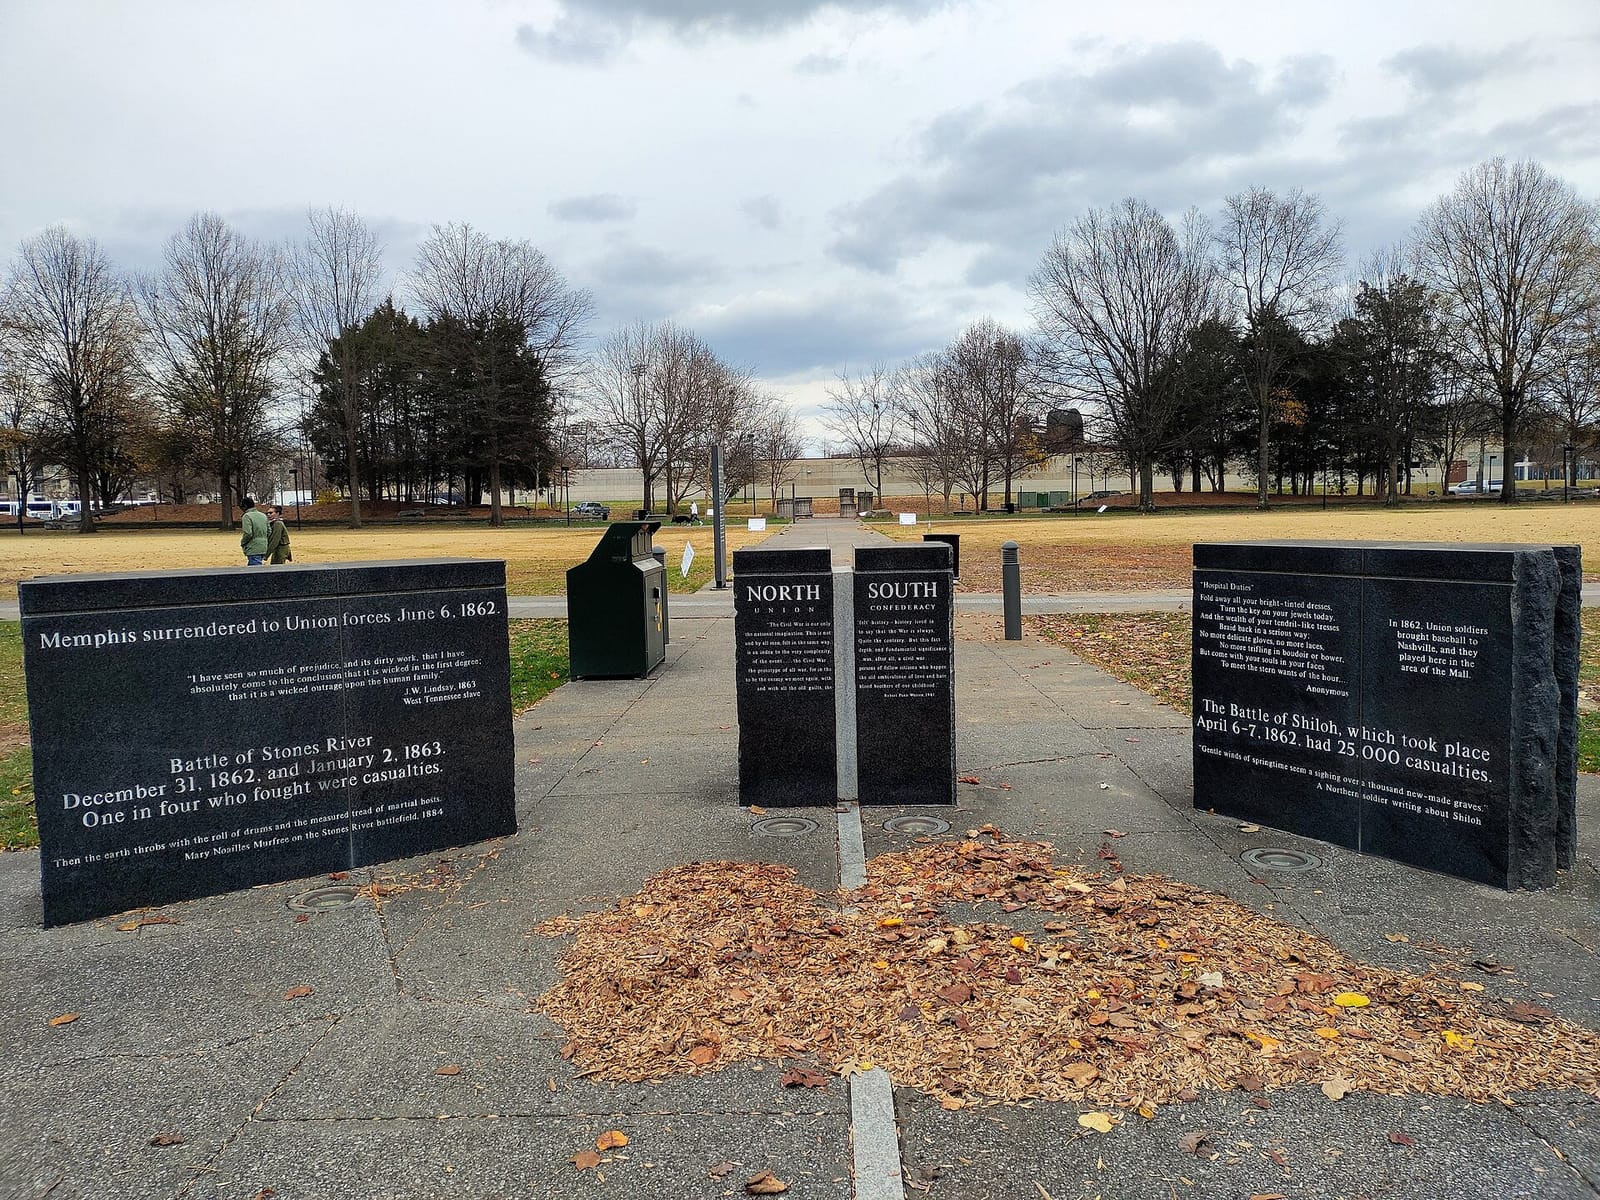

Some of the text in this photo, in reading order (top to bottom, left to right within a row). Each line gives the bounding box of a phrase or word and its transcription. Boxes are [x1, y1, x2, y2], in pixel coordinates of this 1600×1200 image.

[746, 585, 820, 601] NORTH
[867, 582, 937, 598] SOUTH
[39, 629, 137, 648] Memphis
[142, 620, 256, 641] surrendered
[261, 620, 280, 632] to
[285, 615, 337, 630] Union
[342, 613, 391, 625] forces
[397, 608, 435, 621] June
[461, 601, 500, 616] 1862.
[1389, 619, 1398, 627] In
[1426, 622, 1452, 631] Union
[1454, 625, 1488, 634] soldiers
[1397, 631, 1429, 641] brought
[1432, 634, 1466, 643] baseball
[1399, 653, 1475, 667] played here in the
[1459, 648, 1478, 658] they
[259, 667, 284, 675] much
[287, 665, 297, 673] of
[344, 659, 358, 667] and
[1432, 667, 1446, 675] the
[1449, 668, 1471, 678] Mall.
[458, 680, 476, 689] 1863
[424, 694, 461, 702] Tennessee
[1202, 699, 1225, 714] The
[1229, 704, 1269, 722] Battle
[1273, 712, 1289, 725] of
[1347, 727, 1395, 744] which
[1401, 735, 1437, 751] took
[1444, 742, 1490, 761] place
[169, 736, 373, 773] Battle of Stones River
[1196, 716, 1227, 731] April
[1305, 735, 1331, 751] had
[1337, 740, 1400, 764] 25,000
[1405, 757, 1492, 782] casualties.
[63, 785, 166, 808] December
[267, 763, 299, 779] and
[306, 755, 374, 772] January
[404, 742, 446, 758] 1863.
[1224, 751, 1242, 759] winds
[1252, 758, 1288, 769] springtime
[1314, 770, 1341, 782] sighing
[1342, 777, 1359, 785] over
[1368, 781, 1404, 794] thousand
[1406, 791, 1451, 804] new-made
[81, 762, 443, 827] One in four who fought were casualties.
[1326, 784, 1359, 797] Northern
[1362, 794, 1388, 804] soldier
[1392, 800, 1422, 813] writing
[1425, 807, 1449, 818] about
[1452, 812, 1481, 825] Shiloh
[54, 858, 81, 867] Then
[85, 854, 101, 862] the
[104, 848, 131, 858] earth
[134, 843, 166, 853] throbs
[169, 838, 190, 847] with
[212, 831, 228, 841] roll
[231, 829, 241, 837] of
[244, 826, 273, 834] drums
[275, 821, 291, 830] and
[310, 811, 349, 824] measured
[352, 807, 373, 816] tread
[375, 804, 384, 812] of
[388, 799, 418, 810] martial
[185, 851, 210, 860] Mary
[213, 844, 250, 855] Noailles
[254, 837, 290, 848] Murfree
[305, 831, 319, 839] the
[322, 827, 349, 835] Stones
[352, 822, 373, 830] River
[422, 808, 443, 818] 1884
